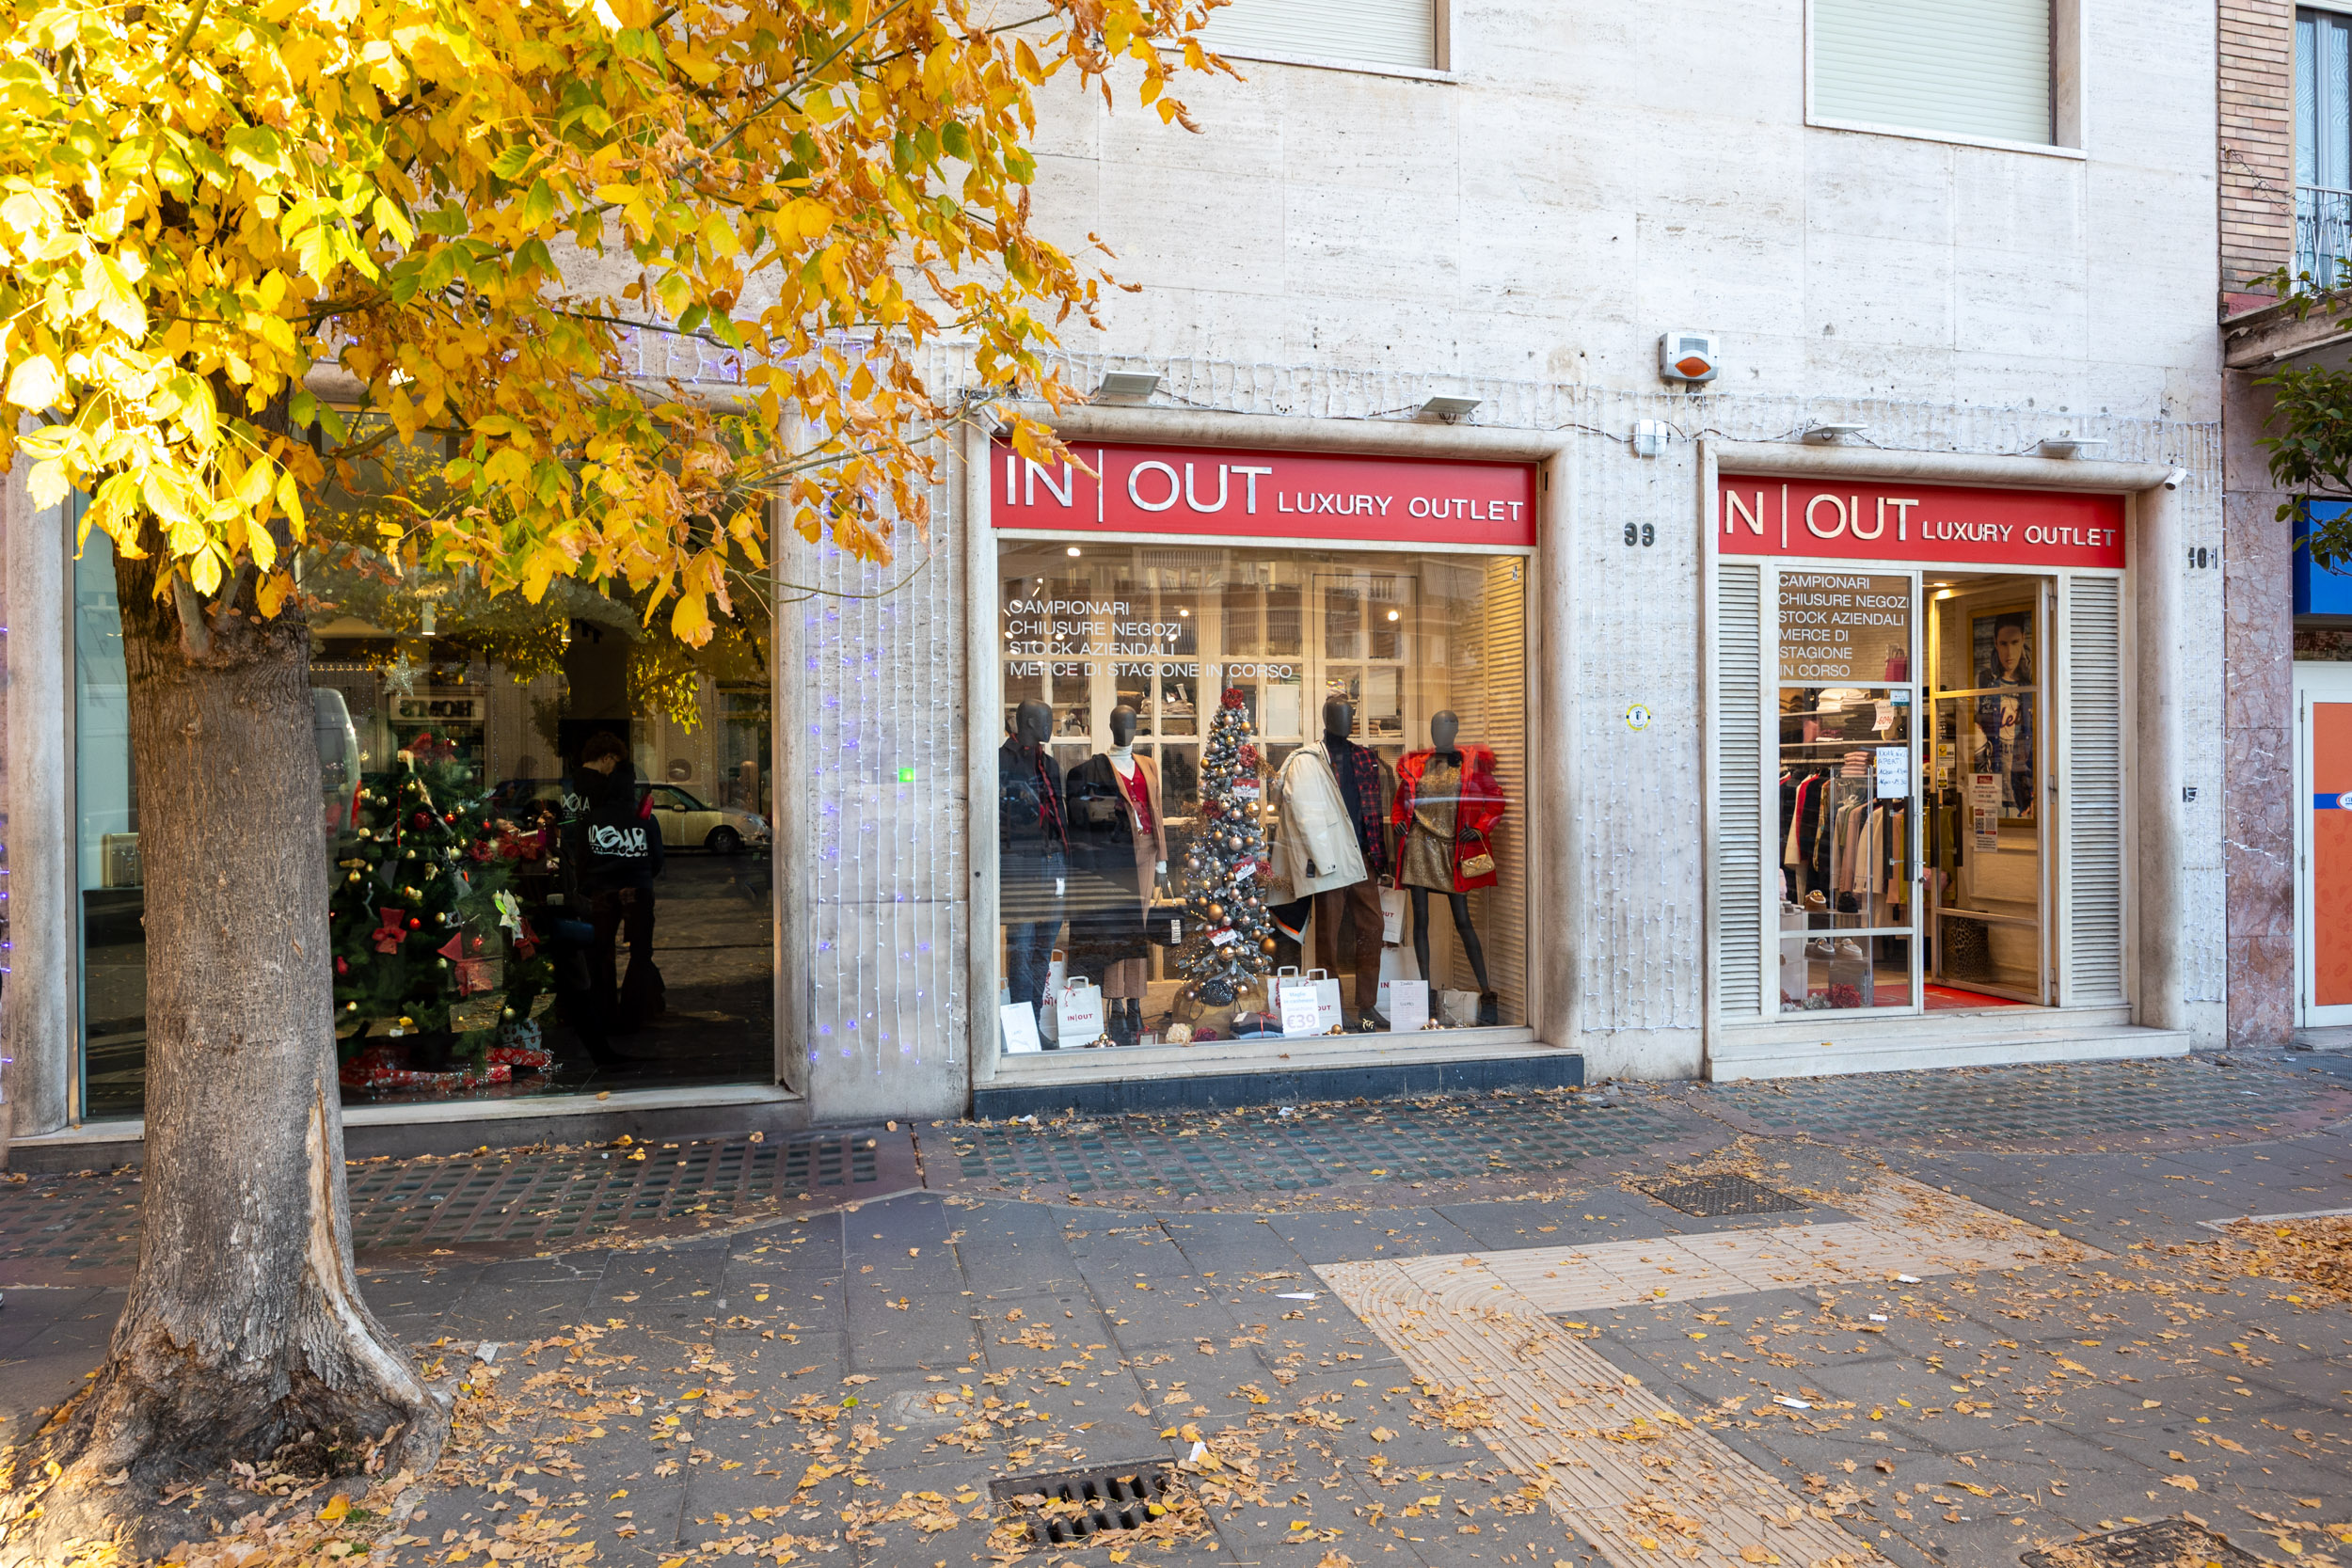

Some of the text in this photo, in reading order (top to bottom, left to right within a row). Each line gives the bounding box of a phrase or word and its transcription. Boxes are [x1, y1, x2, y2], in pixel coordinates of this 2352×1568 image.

[1007, 455, 1524, 522] IN OUT LUXURY OUTLET
[1725, 489, 2116, 546] N OUT LUXURY OUTLET
[1624, 522, 1655, 546] 99
[2187, 547, 2217, 569] 101
[1778, 574, 1870, 590] CAMPIONARI
[1009, 599, 1129, 615] CAMPIONARI
[1778, 593, 1910, 609] CHIUSURE NEGOZI
[1778, 610, 1904, 626] STOCK AZIENDALI
[1009, 620, 1182, 637] CHIUSURE NEGOZI
[1779, 628, 1849, 642] MERCE DI
[1009, 641, 1174, 657] STOCK AZIENDALI
[1779, 646, 1852, 659] STAGIONE
[1010, 661, 1293, 678] MERCE DI STAGIONE IN CORSO
[1779, 664, 1851, 677] IN CORSO
[1287, 1014, 1315, 1029] €39
